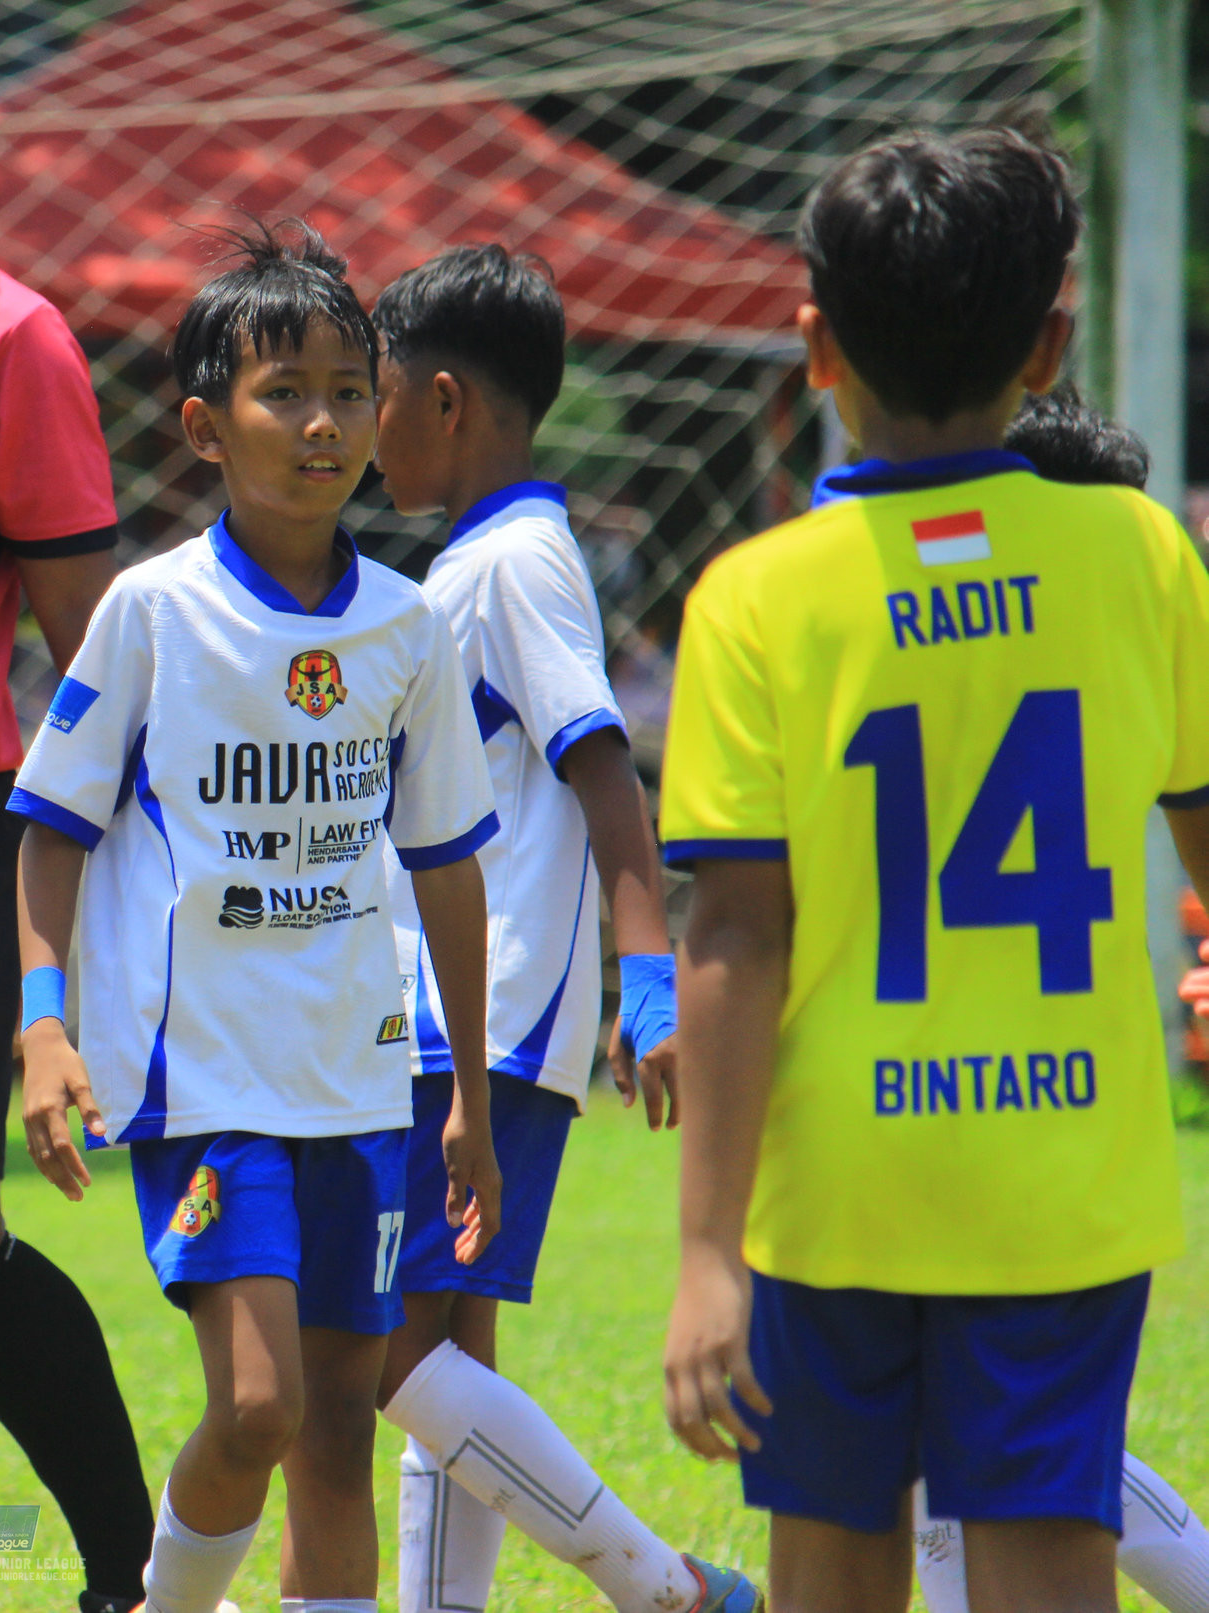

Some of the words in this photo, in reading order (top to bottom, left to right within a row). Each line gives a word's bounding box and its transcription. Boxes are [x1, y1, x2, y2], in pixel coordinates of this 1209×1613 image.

[887, 574, 1041, 649] RADIT
[198, 741, 331, 804] JAVA
[307, 856, 325, 864] AND
[310, 823, 356, 844] LAW
[844, 688, 1114, 1004] 14
[270, 913, 305, 922] FLOAT
[875, 1051, 1098, 1117] BINTARO
[373, 1210, 405, 1293] 17
